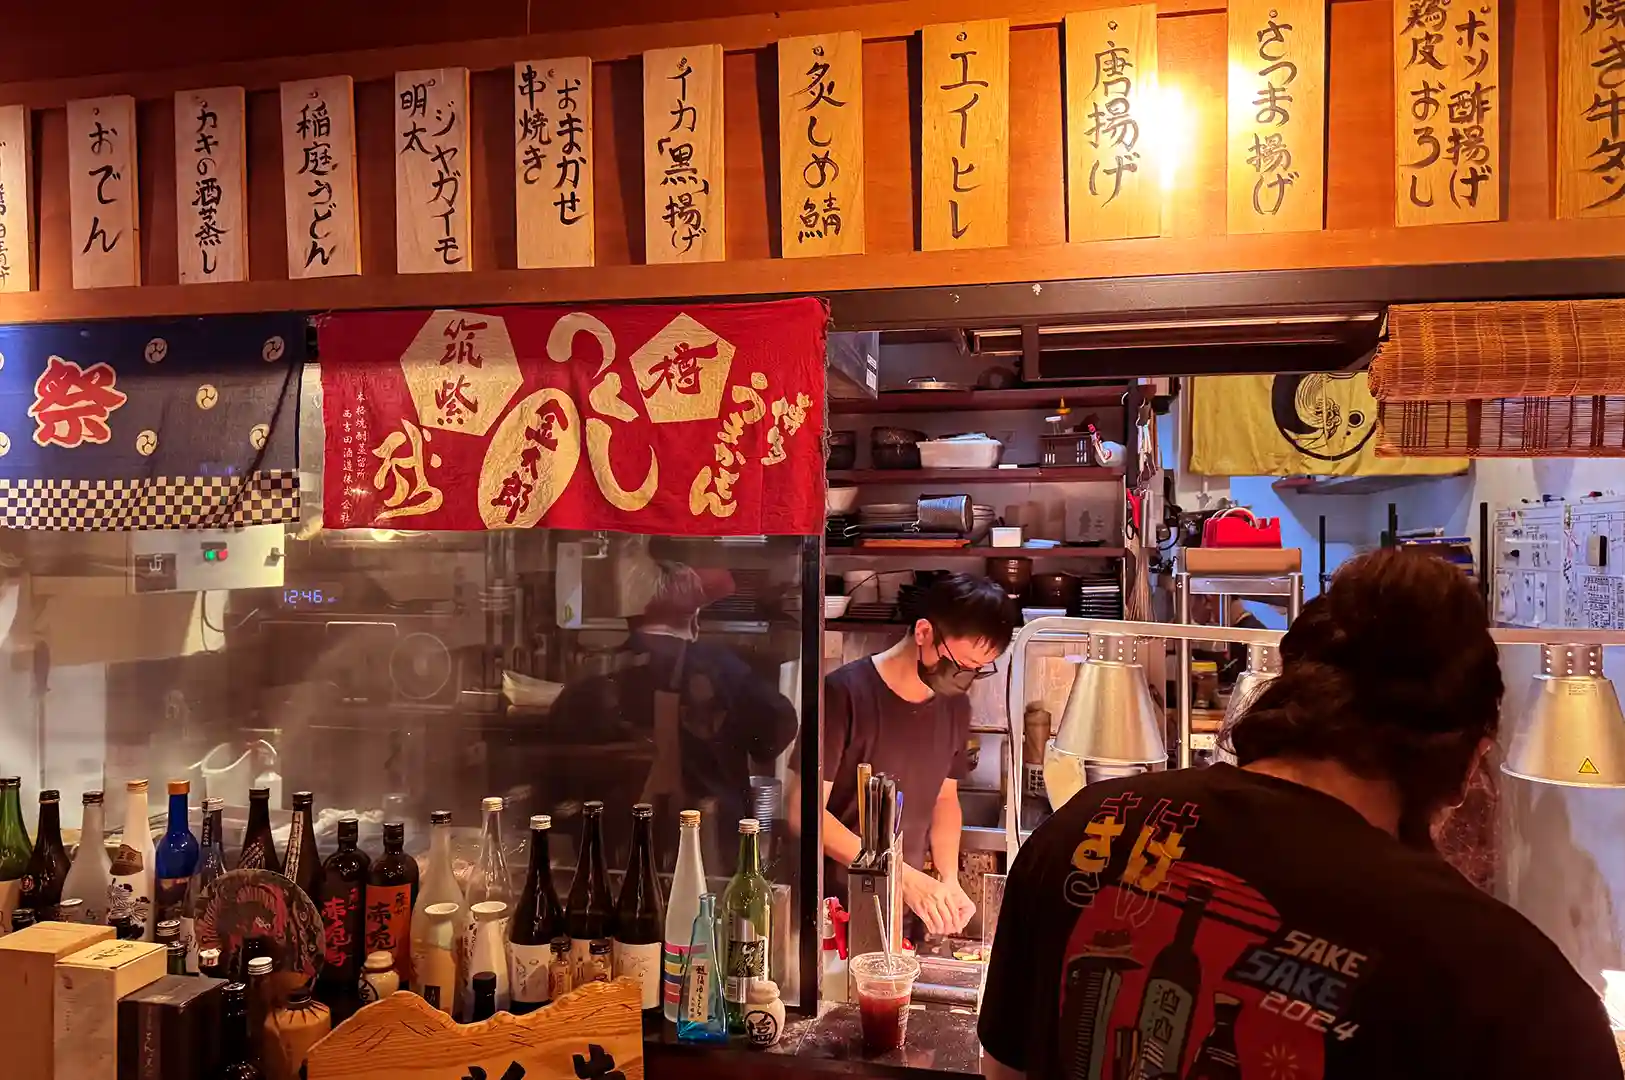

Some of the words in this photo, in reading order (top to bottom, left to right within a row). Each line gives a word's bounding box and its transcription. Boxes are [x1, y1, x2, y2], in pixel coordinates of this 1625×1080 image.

[400, 83, 431, 156] 明太
[517, 65, 552, 185] 串焼き
[552, 78, 588, 226] おまかせ
[790, 61, 848, 244] 炙しめ鯖
[940, 50, 989, 240] エイヒレ
[1084, 40, 1142, 208] 唐揚げ
[1246, 20, 1300, 216] さつま揚げ
[1442, 6, 1497, 210] ポン酢揚げ
[82, 121, 121, 255] おでん
[191, 107, 231, 275] カキの酒蒸し
[296, 101, 338, 269] 稲庭うどん
[28, 355, 127, 448] 祭
[435, 318, 488, 426] 筑紫
[547, 311, 660, 512] つくし
[1234, 949, 1348, 1012] SAKE
[1260, 990, 1361, 1042] 2024
[1273, 929, 1368, 979] SAKE
